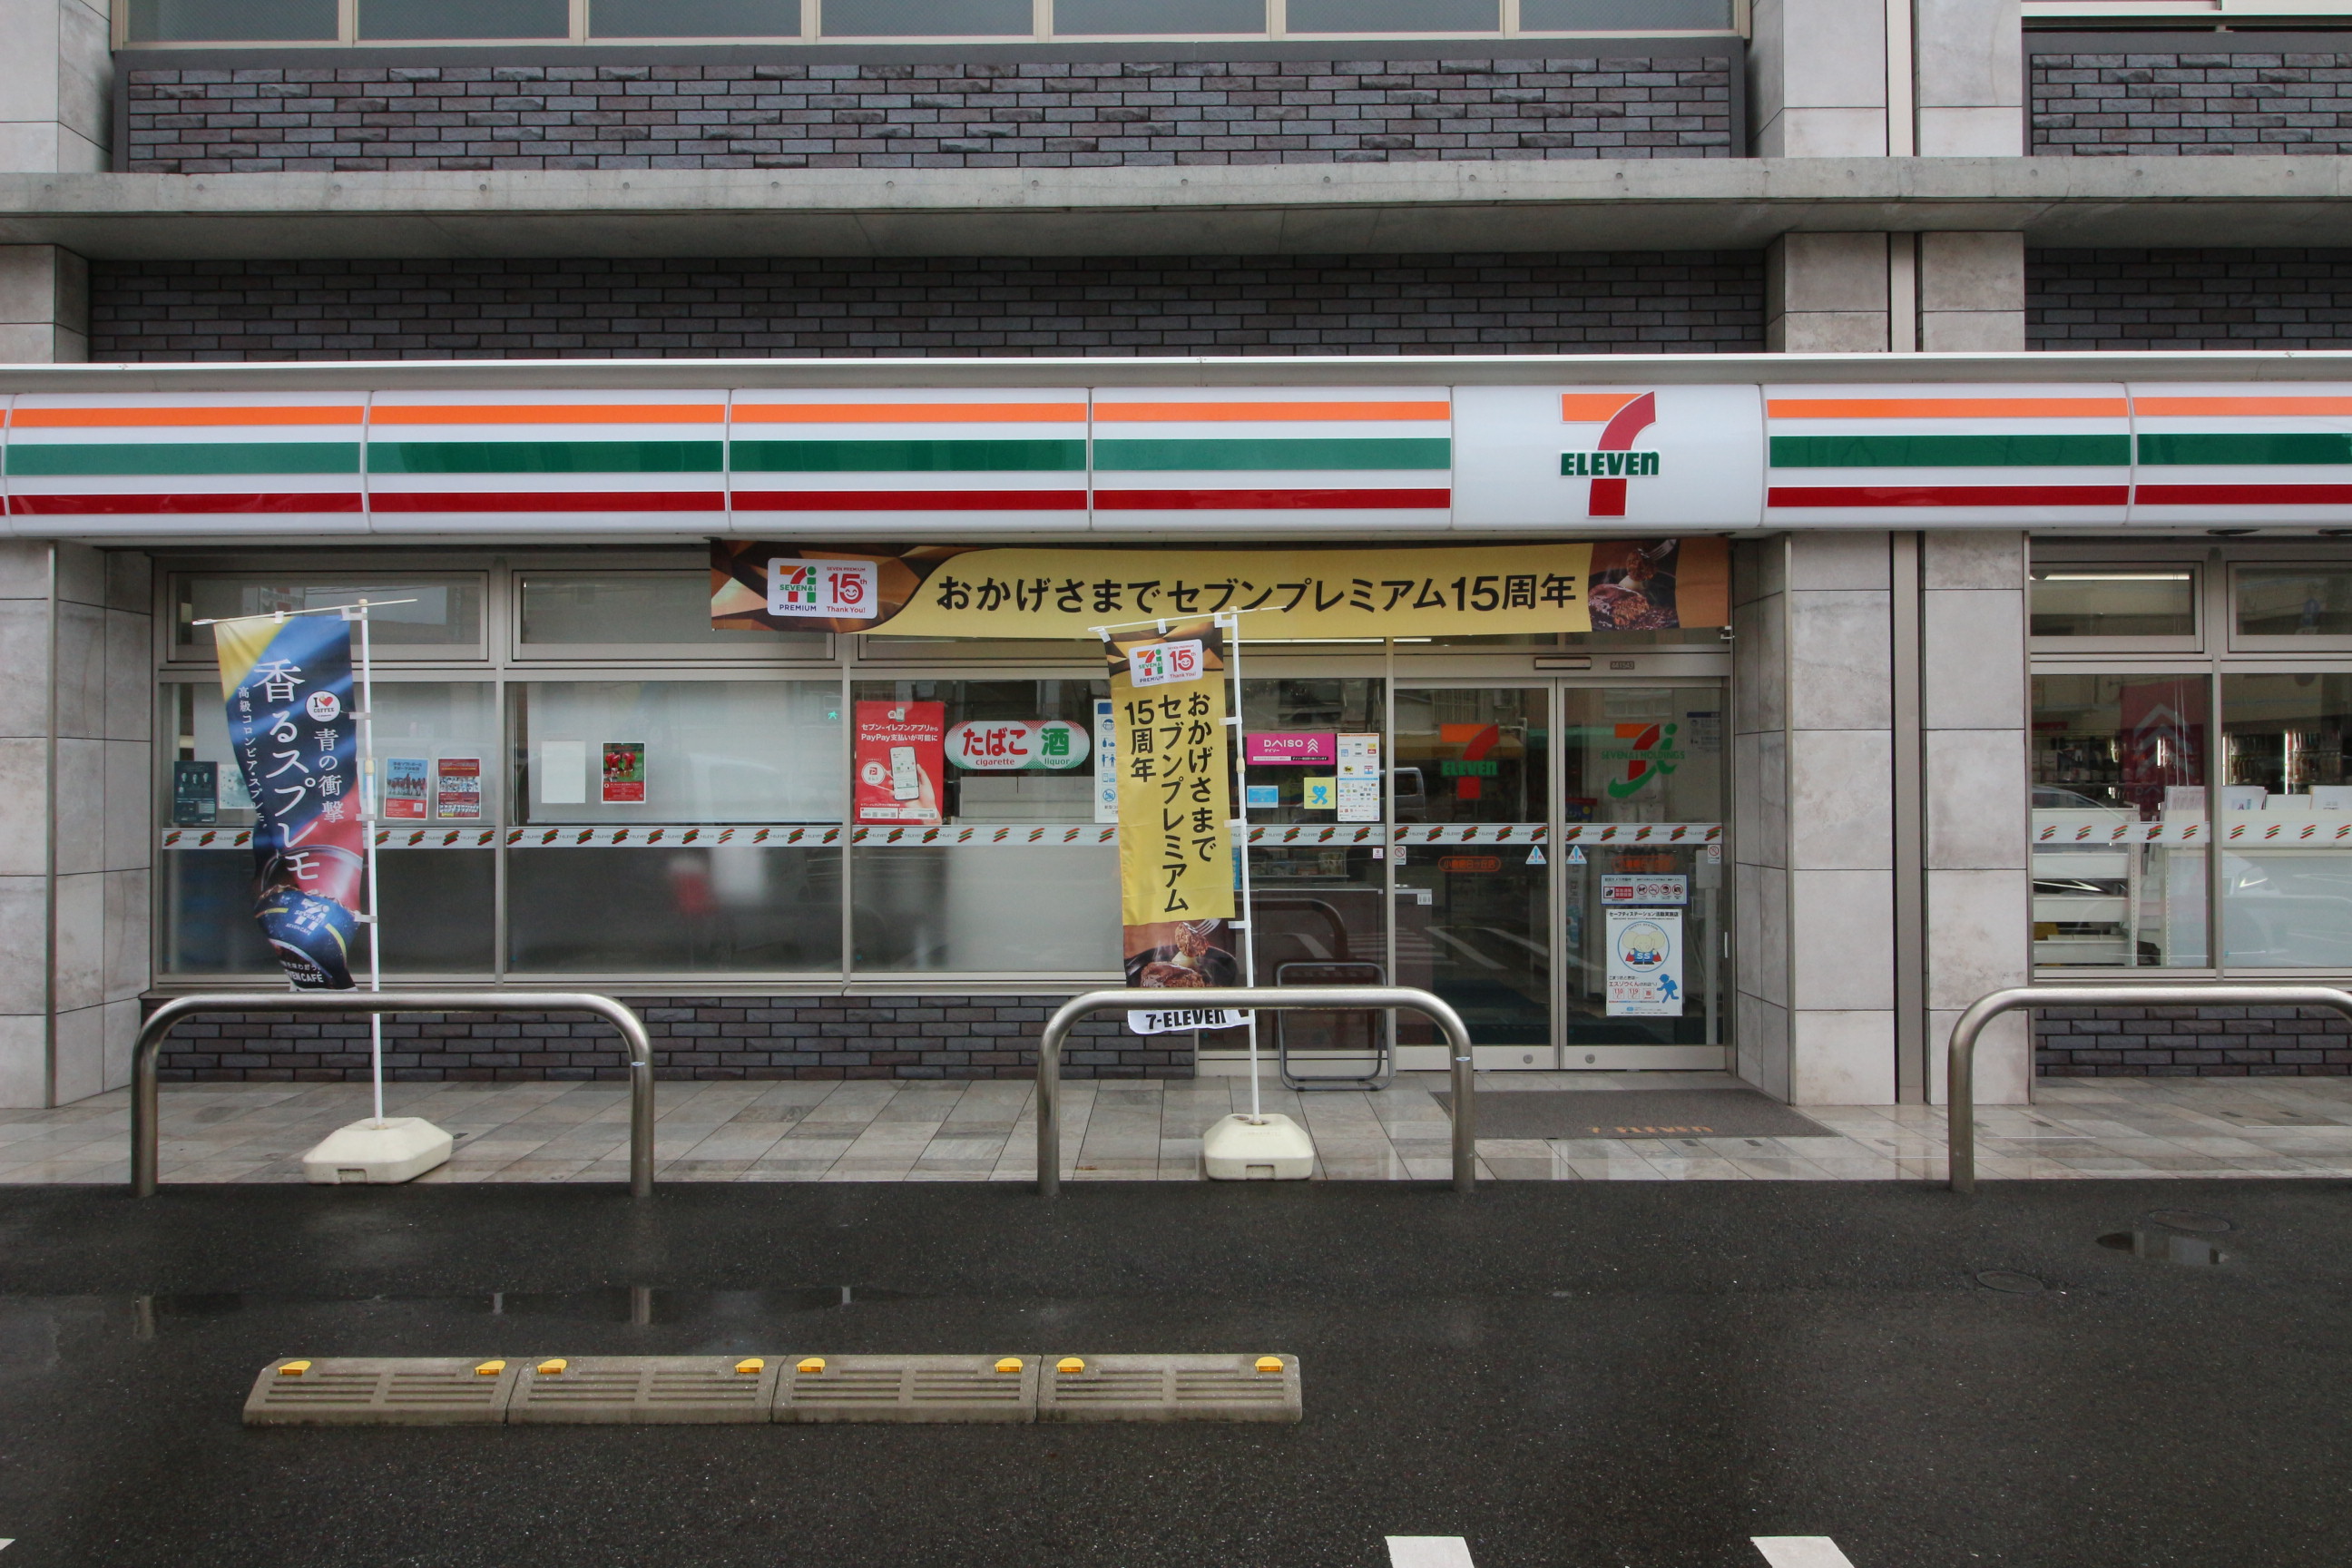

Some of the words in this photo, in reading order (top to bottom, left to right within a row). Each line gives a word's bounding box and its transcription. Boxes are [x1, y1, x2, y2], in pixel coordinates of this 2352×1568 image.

[936, 573, 1576, 614] おかげさまでセブンプレミアム15周年
[779, 603, 817, 612] PREMIUM
[827, 605, 848, 613] Thank
[1139, 675, 1164, 683] PREMIUM
[963, 727, 1028, 757] たばこ
[1041, 728, 1070, 756] 酒
[1124, 699, 1157, 783] 15周年
[1263, 740, 1304, 748] DAISO
[1640, 750, 1685, 760] HOLDINGS
[975, 758, 1015, 767] cigarette
[1044, 758, 1071, 767] liquor
[252, 658, 320, 880] 香るスプレモ
[314, 728, 345, 823] 青の衝撃
[1187, 691, 1217, 862] おかげさまで
[1158, 694, 1190, 913] セブンプレミアム
[1636, 952, 1651, 960] SS
[301, 971, 324, 983] CAFÉ
